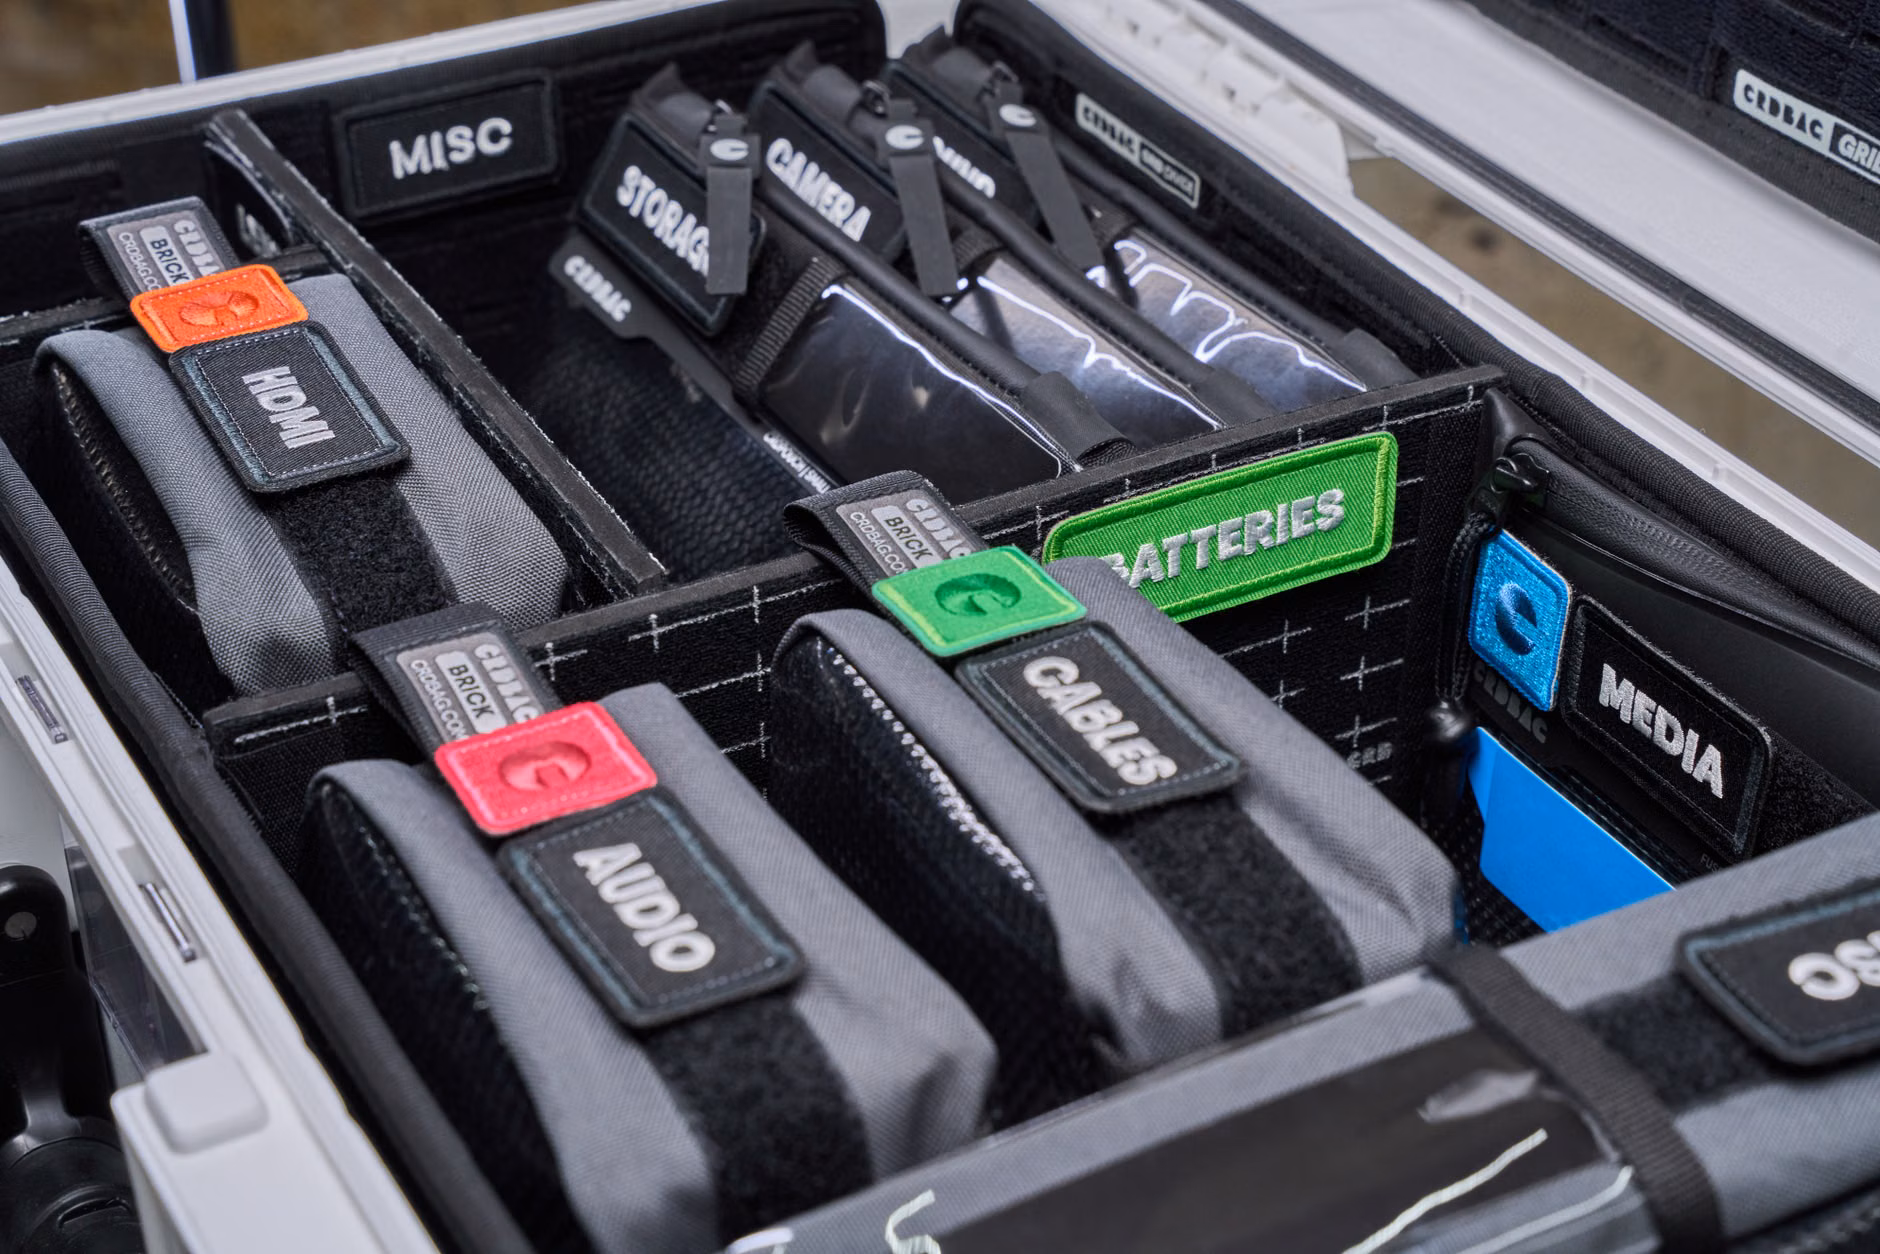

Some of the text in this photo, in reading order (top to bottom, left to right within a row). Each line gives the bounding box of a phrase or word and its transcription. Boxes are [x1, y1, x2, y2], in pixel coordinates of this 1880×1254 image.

[388, 117, 513, 180] MISC
[766, 137, 872, 242] CAMERA
[119, 231, 161, 291] CRDBAG.CO
[150, 238, 190, 283] BRICK
[240, 366, 336, 449] HDMI
[850, 511, 910, 575] CRDBAG.CO
[883, 516, 933, 560] BRICK
[448, 663, 495, 719] BRICK
[1022, 655, 1178, 786] CABLES
[1598, 662, 1724, 799] MEDIA
[572, 842, 716, 973] AUDIO
